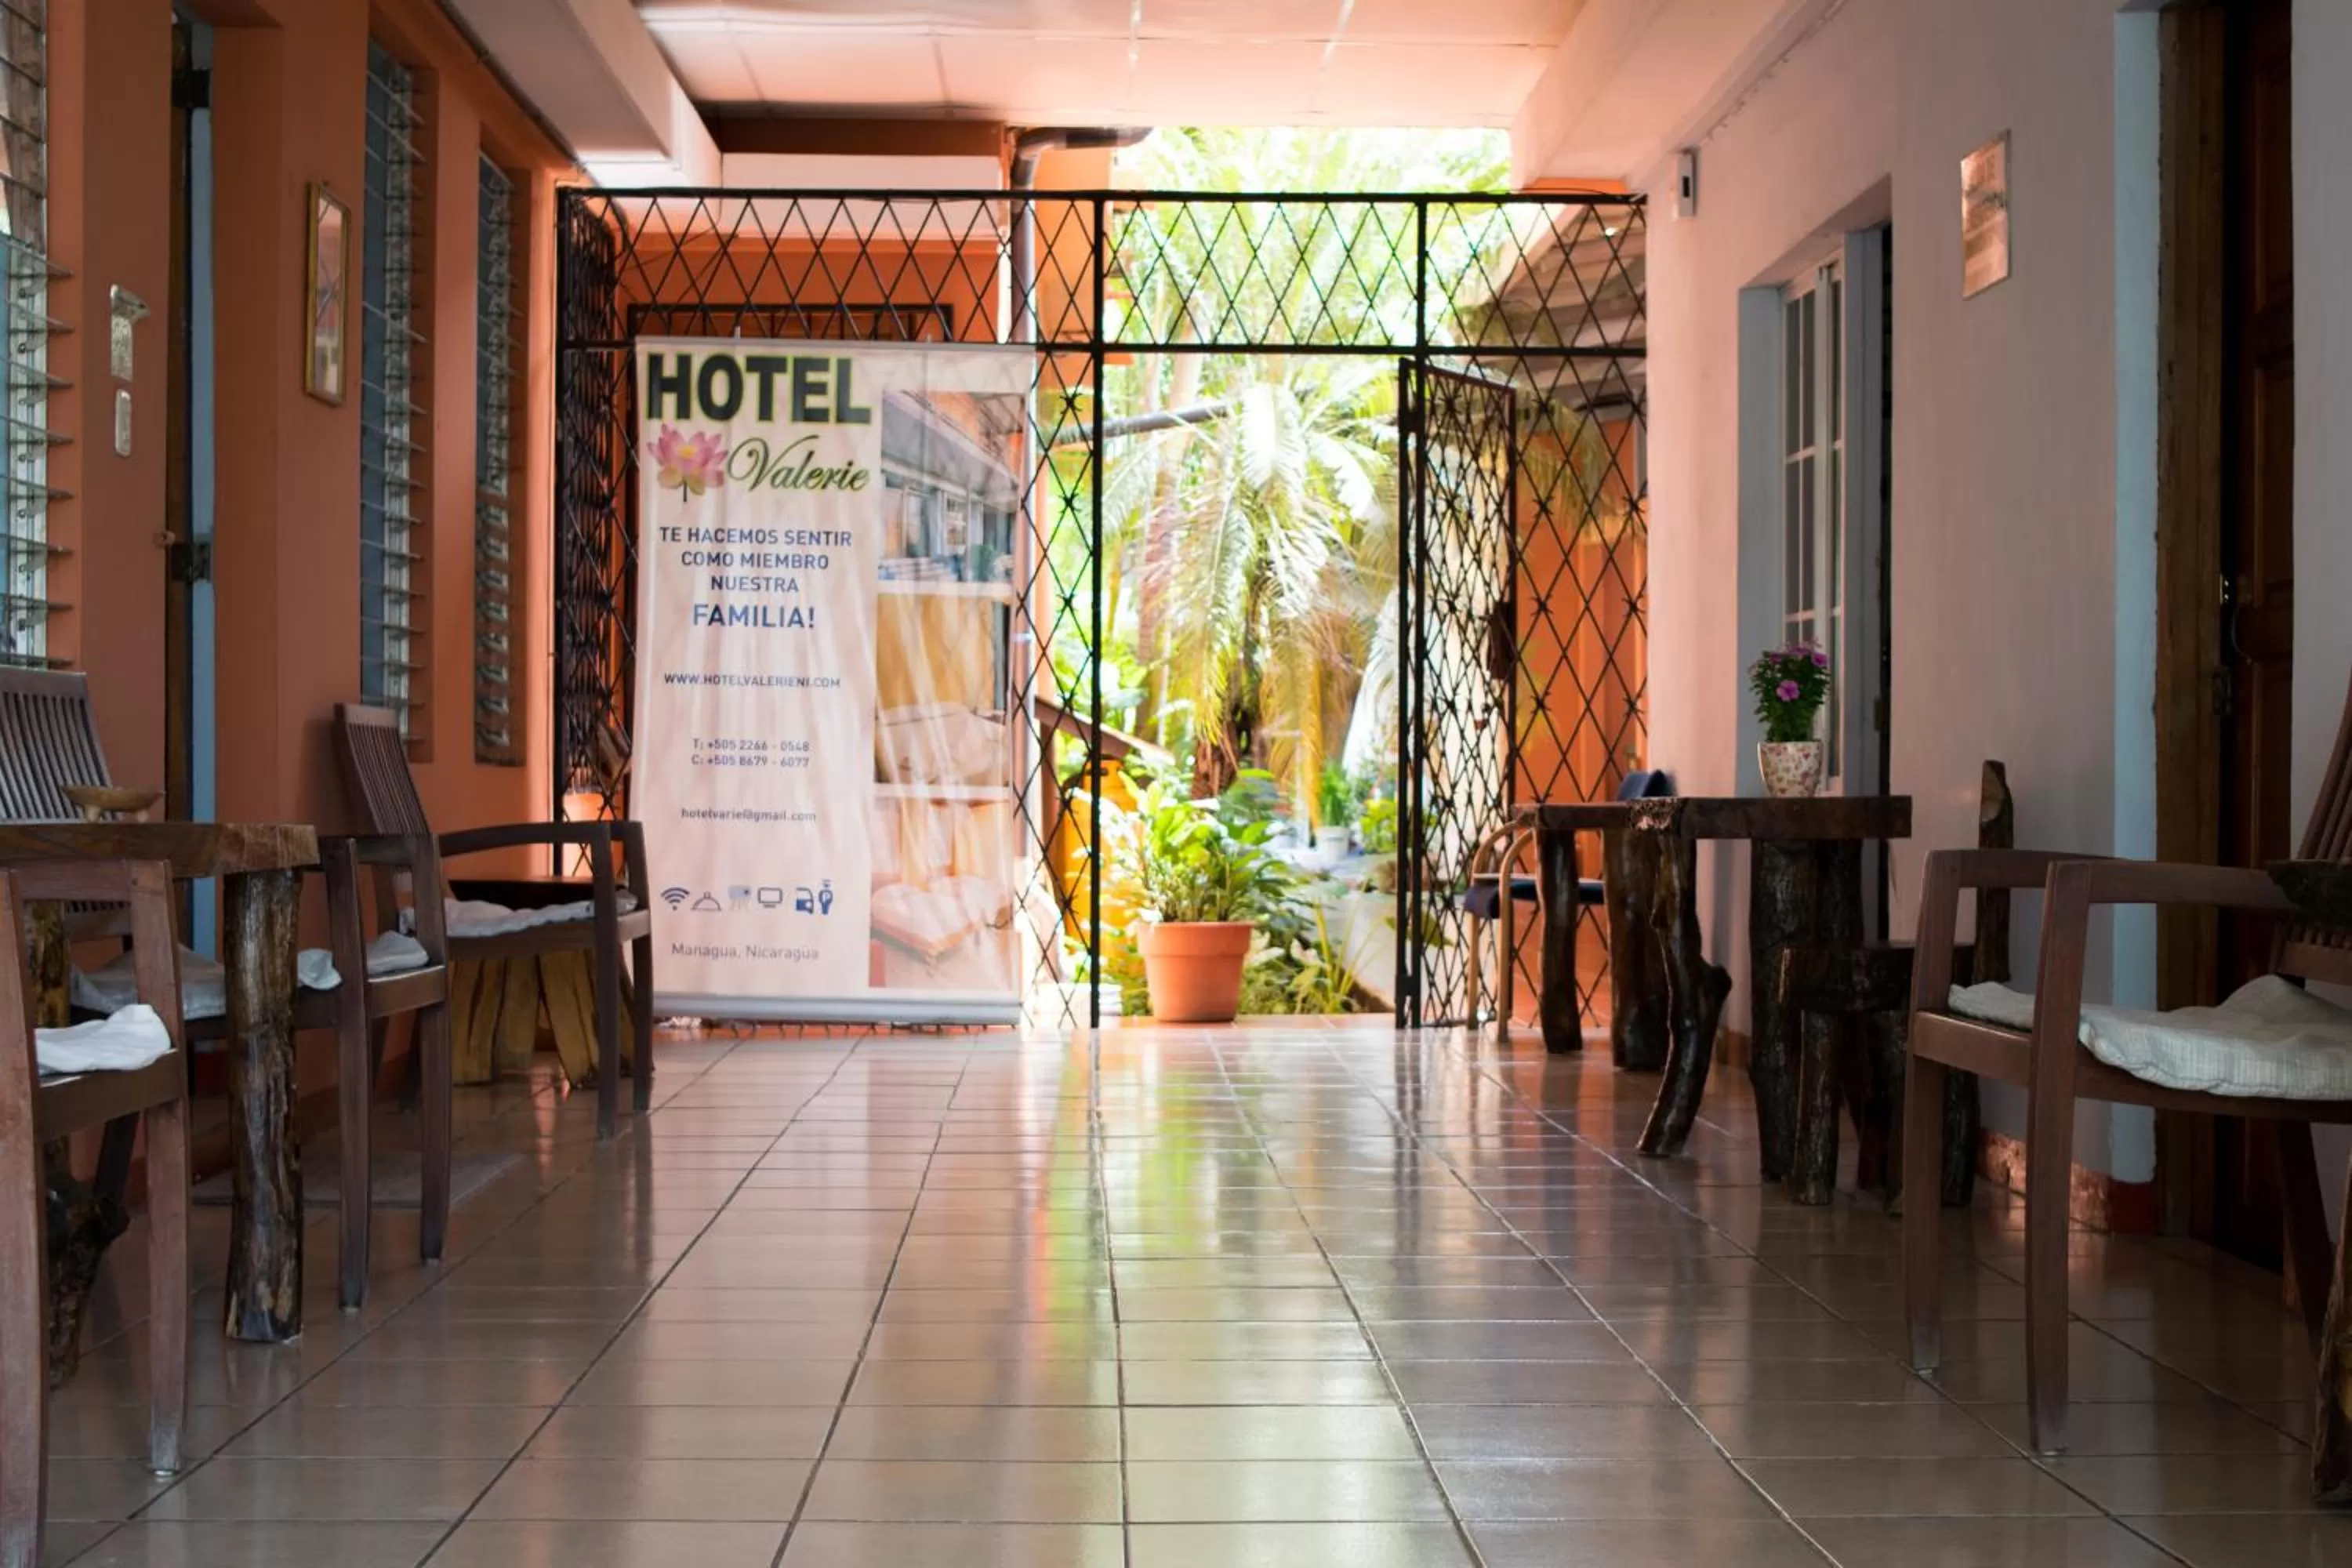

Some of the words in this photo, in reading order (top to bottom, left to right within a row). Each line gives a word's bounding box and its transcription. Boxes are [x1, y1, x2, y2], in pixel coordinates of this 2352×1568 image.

[645, 350, 872, 425] HOTEL
[728, 434, 869, 492] Valerie
[659, 527, 682, 543] TE
[688, 527, 779, 544] HACEMOS
[784, 529, 852, 546] SENTIR
[681, 551, 734, 567] COMO
[740, 552, 829, 569] MIEMBRO
[711, 575, 799, 593] NUESTRA
[693, 604, 815, 628] FAMILIA!
[693, 739, 703, 750] T:
[707, 739, 736, 750] +505
[691, 753, 703, 766] C:
[707, 754, 736, 766] +505
[671, 942, 741, 960] Managua,
[746, 944, 819, 963] Nicaragua
